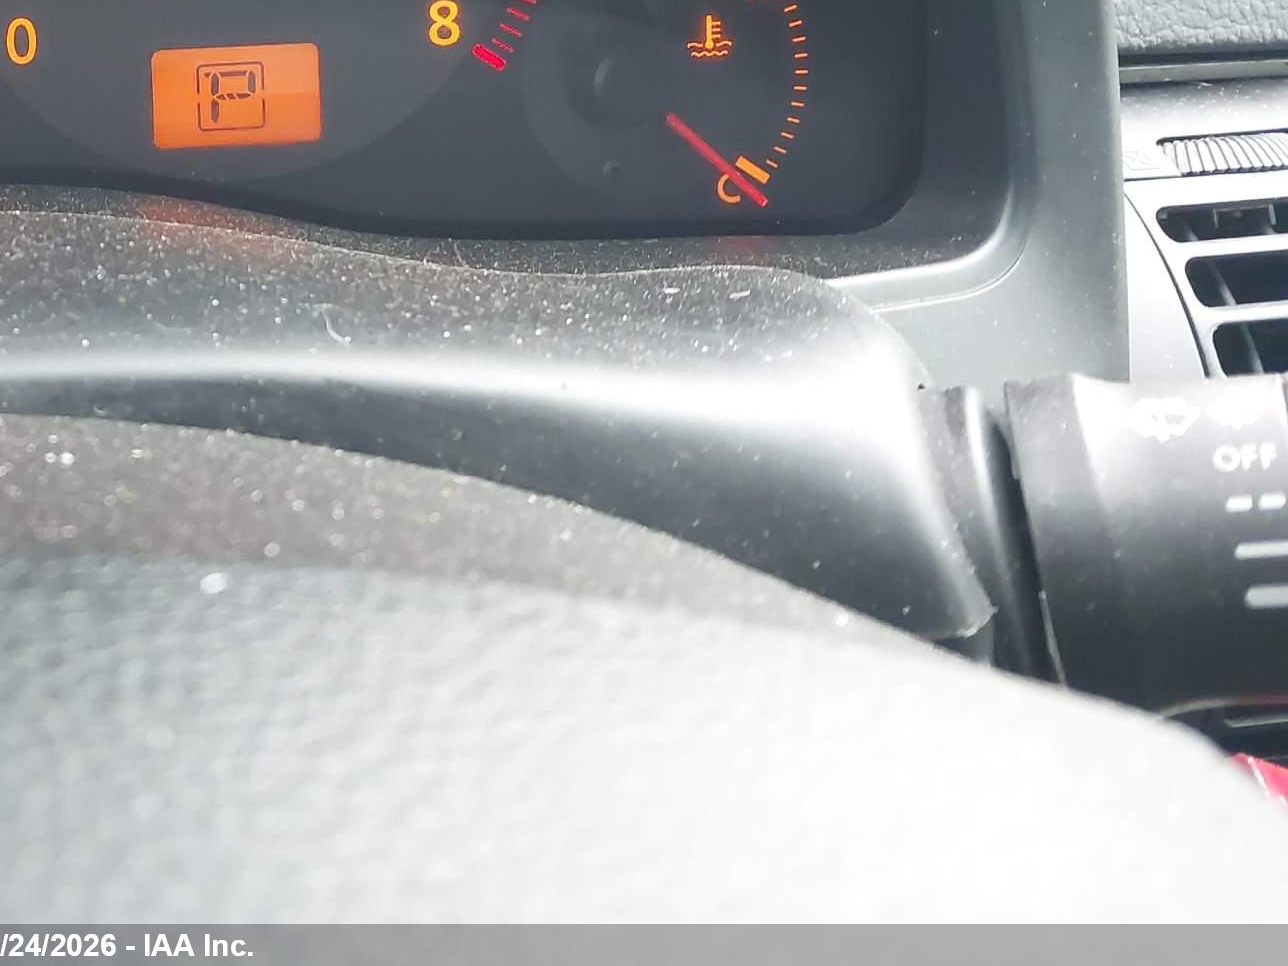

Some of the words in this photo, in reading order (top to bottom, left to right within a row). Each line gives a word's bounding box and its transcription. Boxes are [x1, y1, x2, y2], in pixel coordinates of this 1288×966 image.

[5, 17, 37, 65] 0
[207, 70, 257, 123] P
[1212, 442, 1277, 472] OFF
